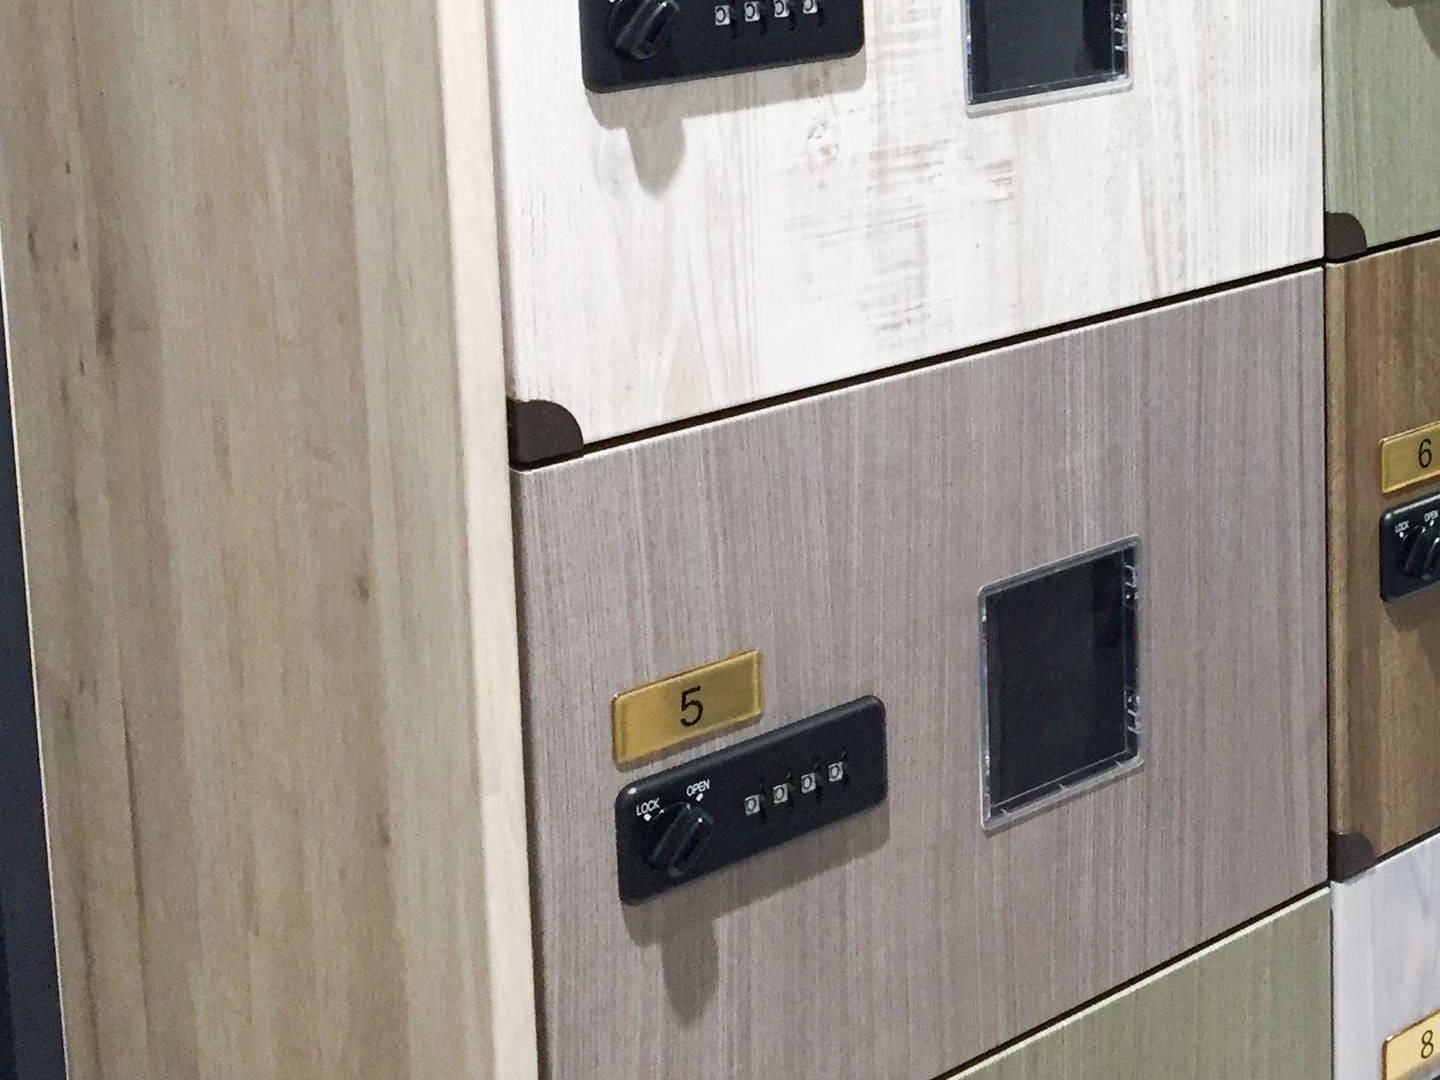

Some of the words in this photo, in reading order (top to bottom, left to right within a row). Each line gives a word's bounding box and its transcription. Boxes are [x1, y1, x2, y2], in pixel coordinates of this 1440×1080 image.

[1418, 438, 1433, 468] 6
[679, 685, 704, 728] 5
[686, 778, 711, 798] OPEN
[635, 796, 661, 817] LOCK
[1420, 1029, 1434, 1059] 8
